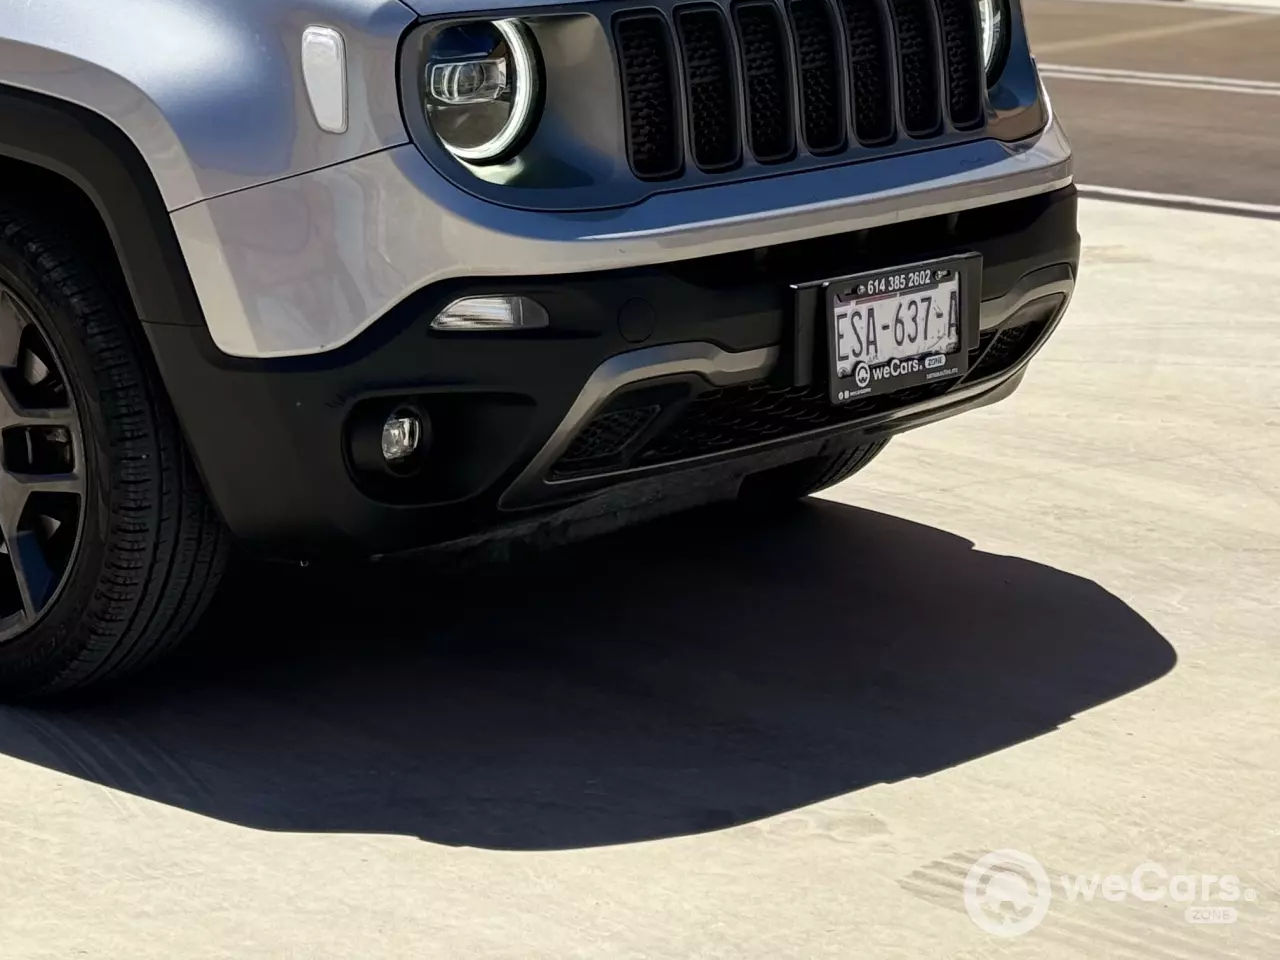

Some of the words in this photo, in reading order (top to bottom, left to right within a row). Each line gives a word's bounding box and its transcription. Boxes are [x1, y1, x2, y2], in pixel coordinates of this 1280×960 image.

[867, 279, 886, 294] 614
[888, 274, 906, 291] 385
[908, 270, 931, 287] 2602
